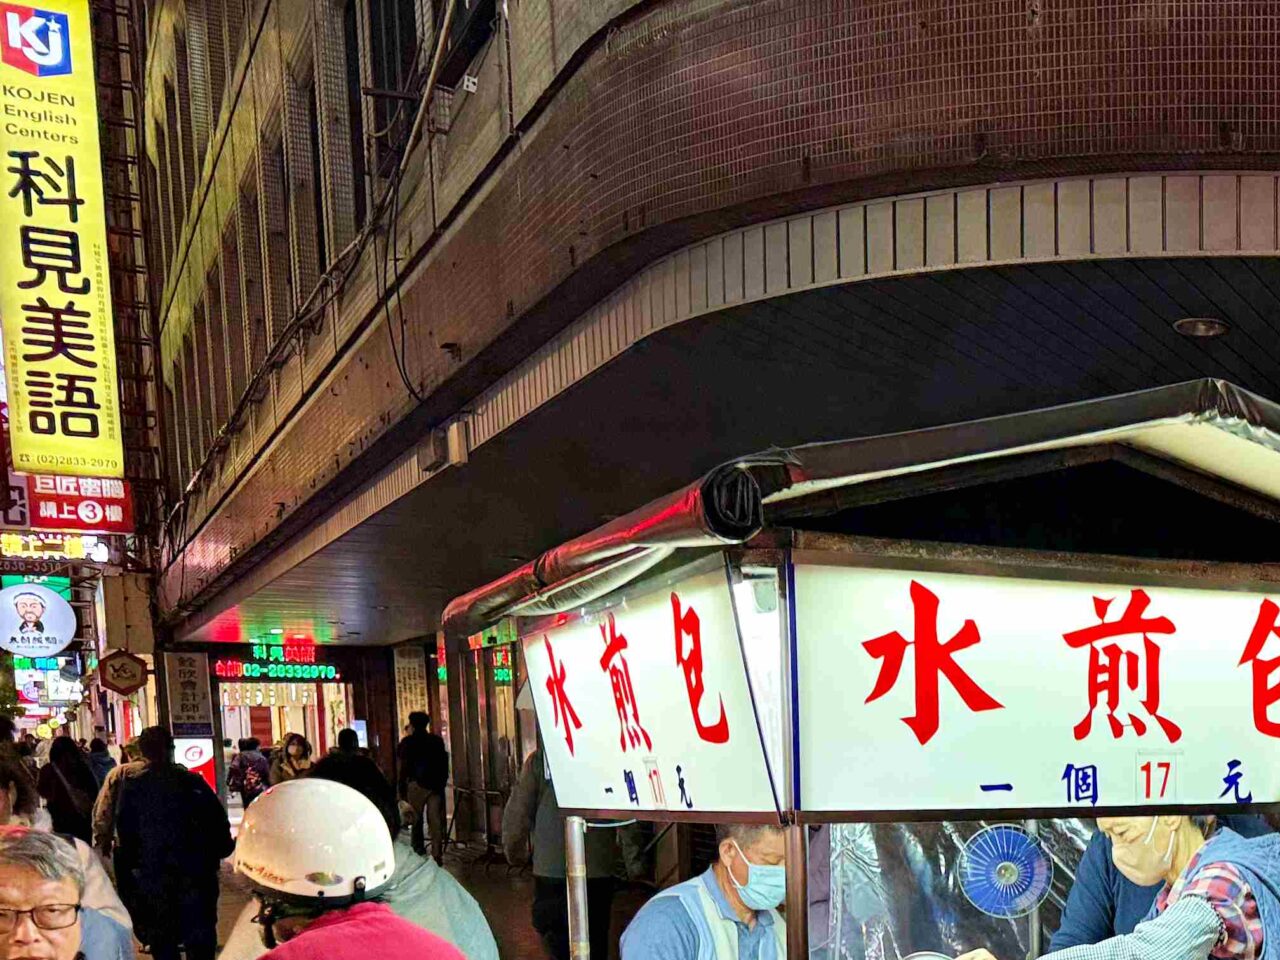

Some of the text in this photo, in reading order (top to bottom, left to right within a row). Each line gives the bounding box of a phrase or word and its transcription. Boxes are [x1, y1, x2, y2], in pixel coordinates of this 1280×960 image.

[2, 84, 76, 108] KOJEN
[4, 104, 78, 127] English
[5, 122, 79, 146] Centers
[7, 150, 101, 439] 科見美語
[544, 590, 730, 758] 水煎包
